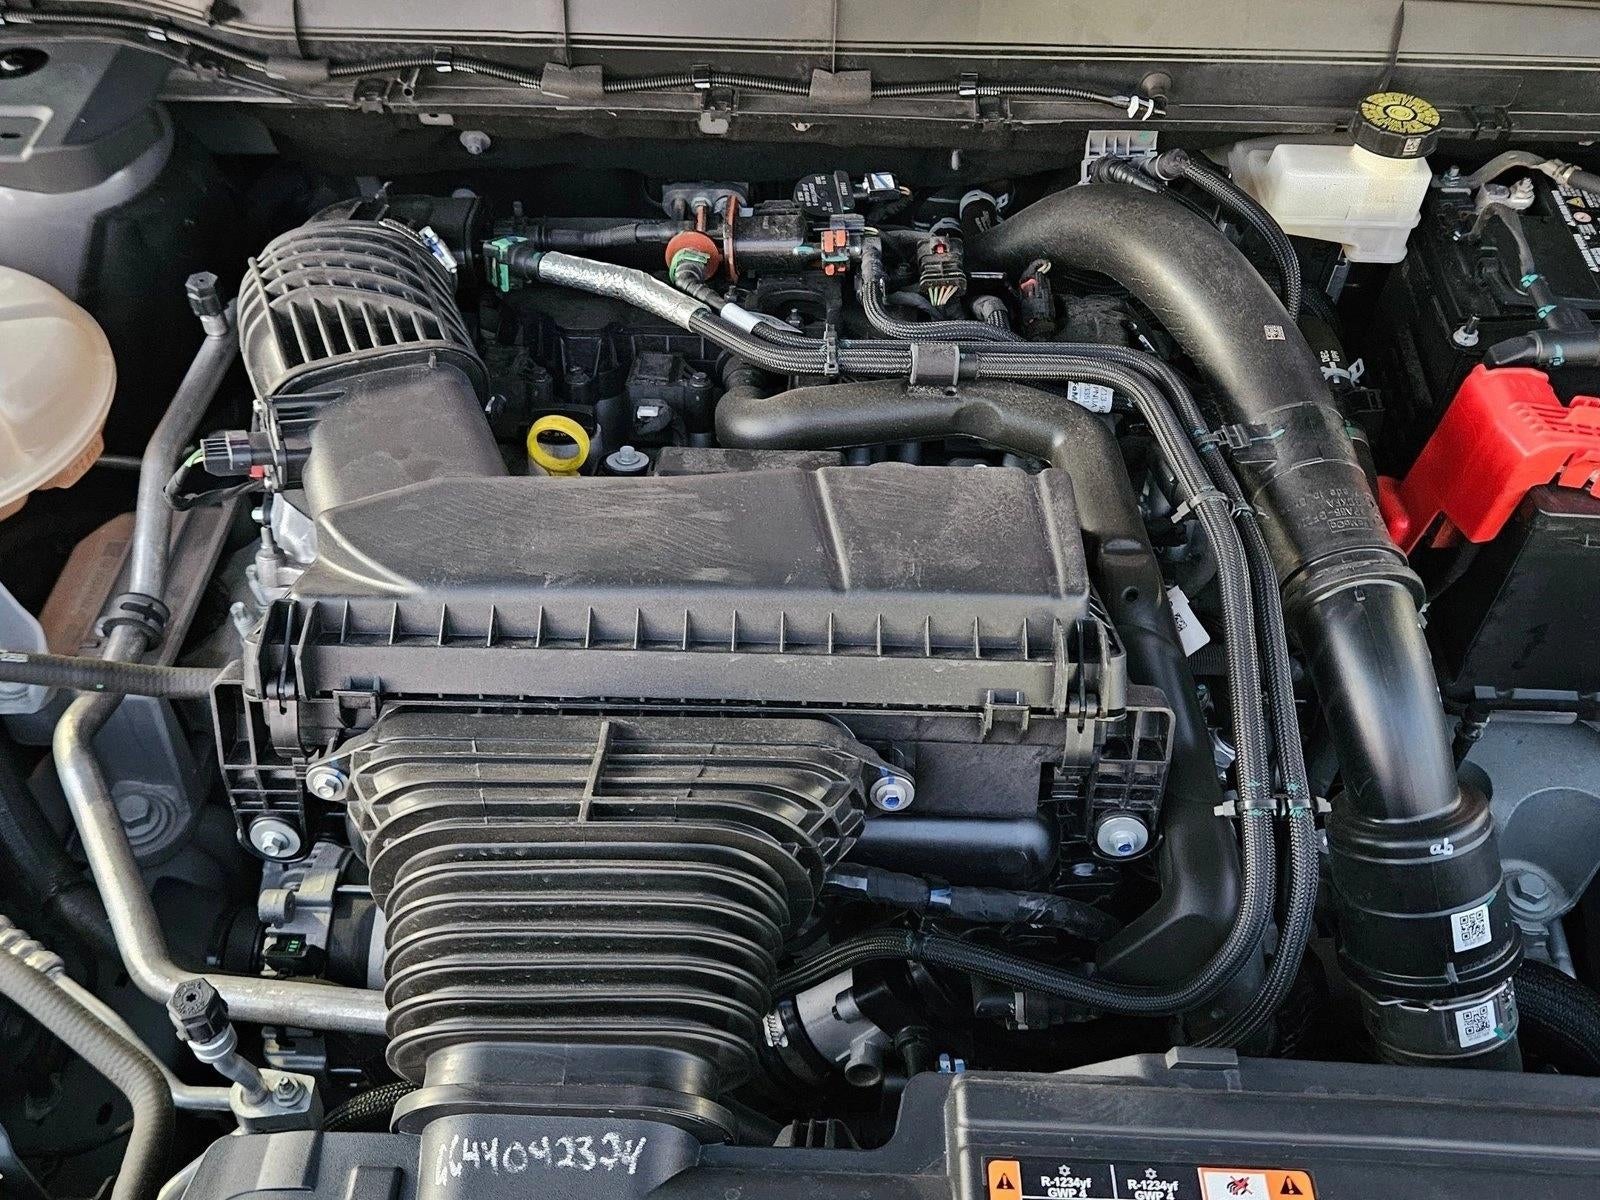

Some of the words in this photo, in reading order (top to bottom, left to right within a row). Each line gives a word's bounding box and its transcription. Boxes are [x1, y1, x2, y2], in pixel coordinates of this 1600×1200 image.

[1040, 1176, 1092, 1190] R-1234yf
[1127, 1179, 1179, 1193] R-1234yf
[1047, 1187, 1077, 1199] GWP
[1078, 1189, 1088, 1199] 4
[1134, 1191, 1165, 1200] GWP
[1166, 1192, 1175, 1200] 4
